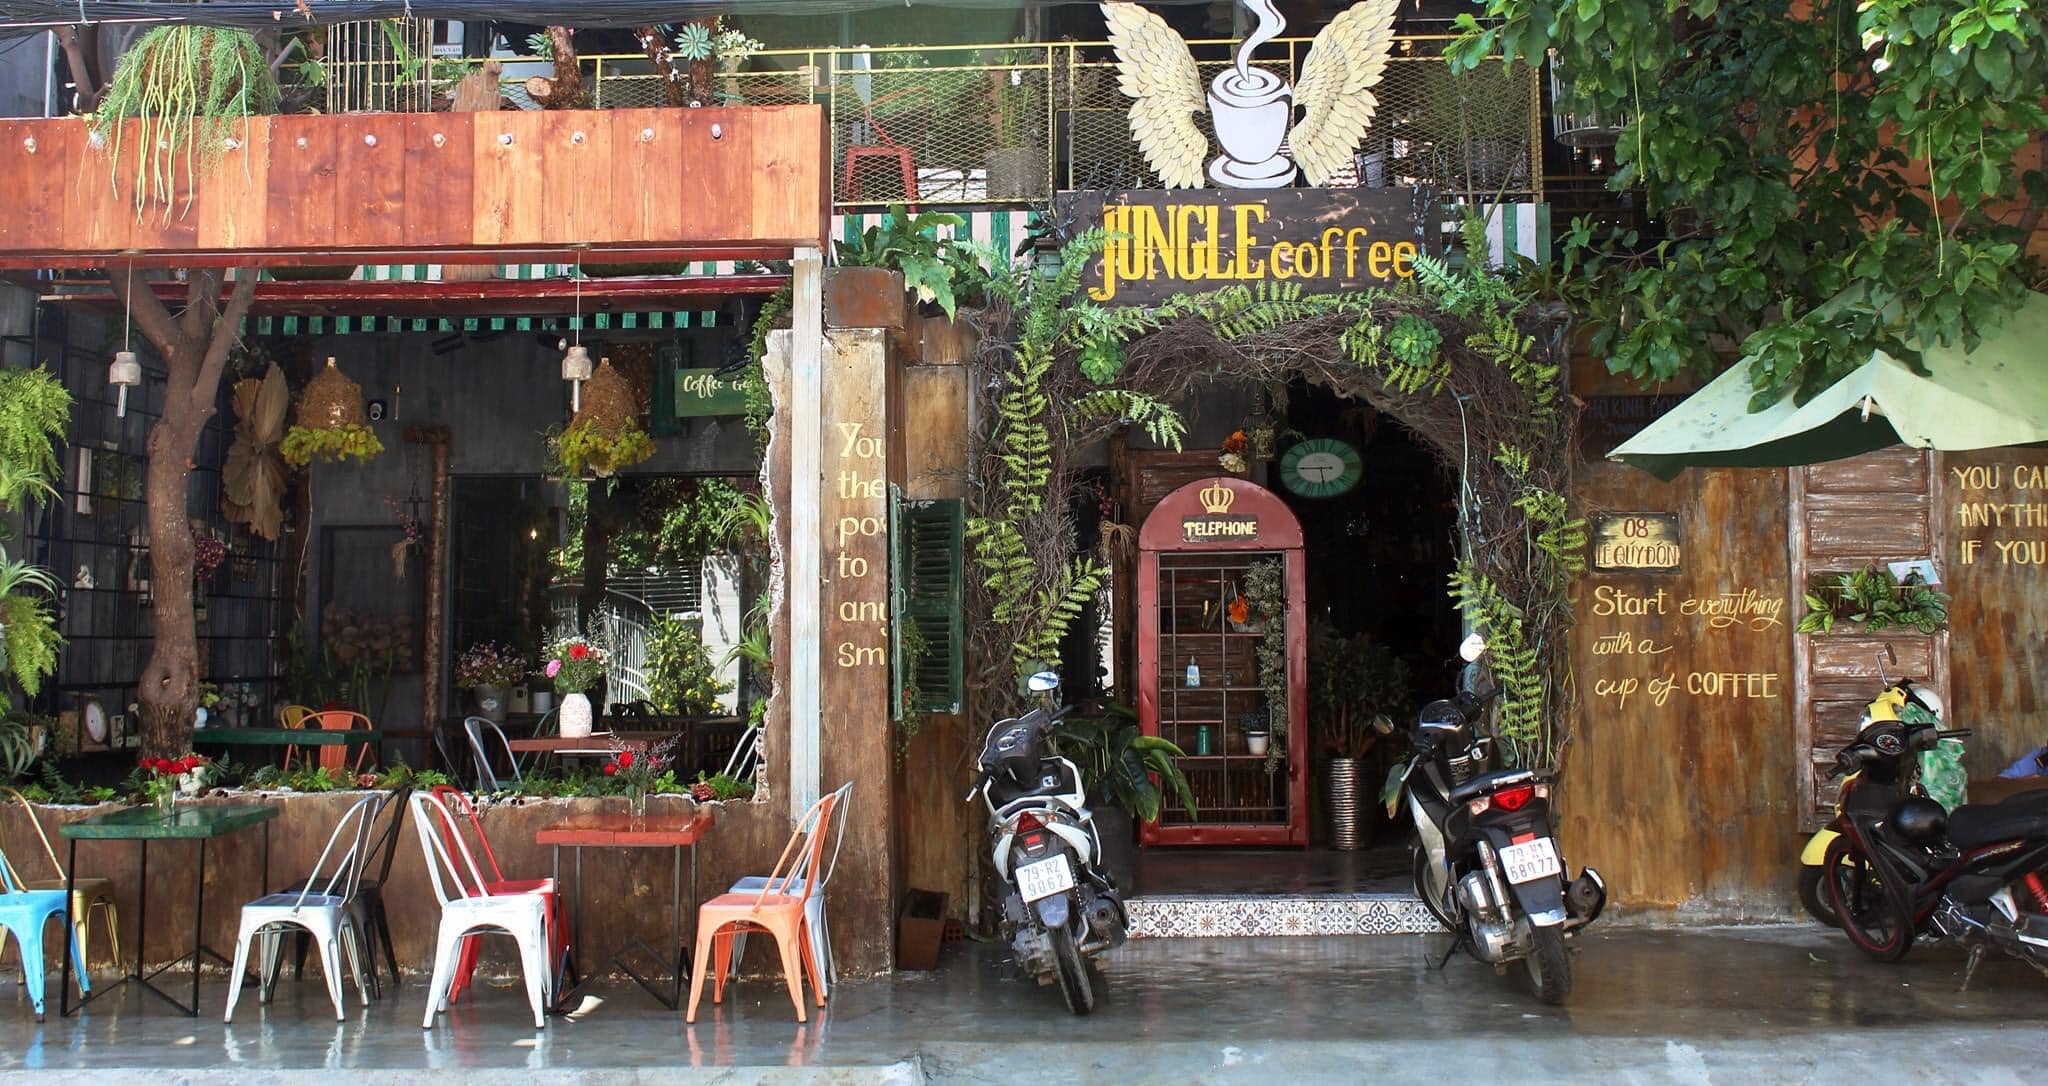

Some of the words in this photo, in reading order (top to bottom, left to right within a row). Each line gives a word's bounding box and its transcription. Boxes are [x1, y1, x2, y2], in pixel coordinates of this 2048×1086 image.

[1089, 203, 1265, 301] JUNGLE
[1271, 227, 1417, 279] coffee
[683, 374, 724, 399] Coffee
[837, 470, 886, 499] the
[1952, 465, 2000, 490] YOU
[1183, 521, 1257, 537] TELEPHONE
[1623, 518, 1649, 539] 08
[837, 551, 868, 578] to
[1961, 540, 1982, 565] IF
[1994, 540, 2046, 565] YOU
[1593, 585, 1667, 616] Start
[1680, 586, 1783, 632] everything
[1592, 631, 1634, 655] with
[1637, 639, 1673, 655] a
[1594, 676, 1639, 711] cup
[1647, 672, 1680, 707] of
[1687, 671, 1778, 698] COFFEE
